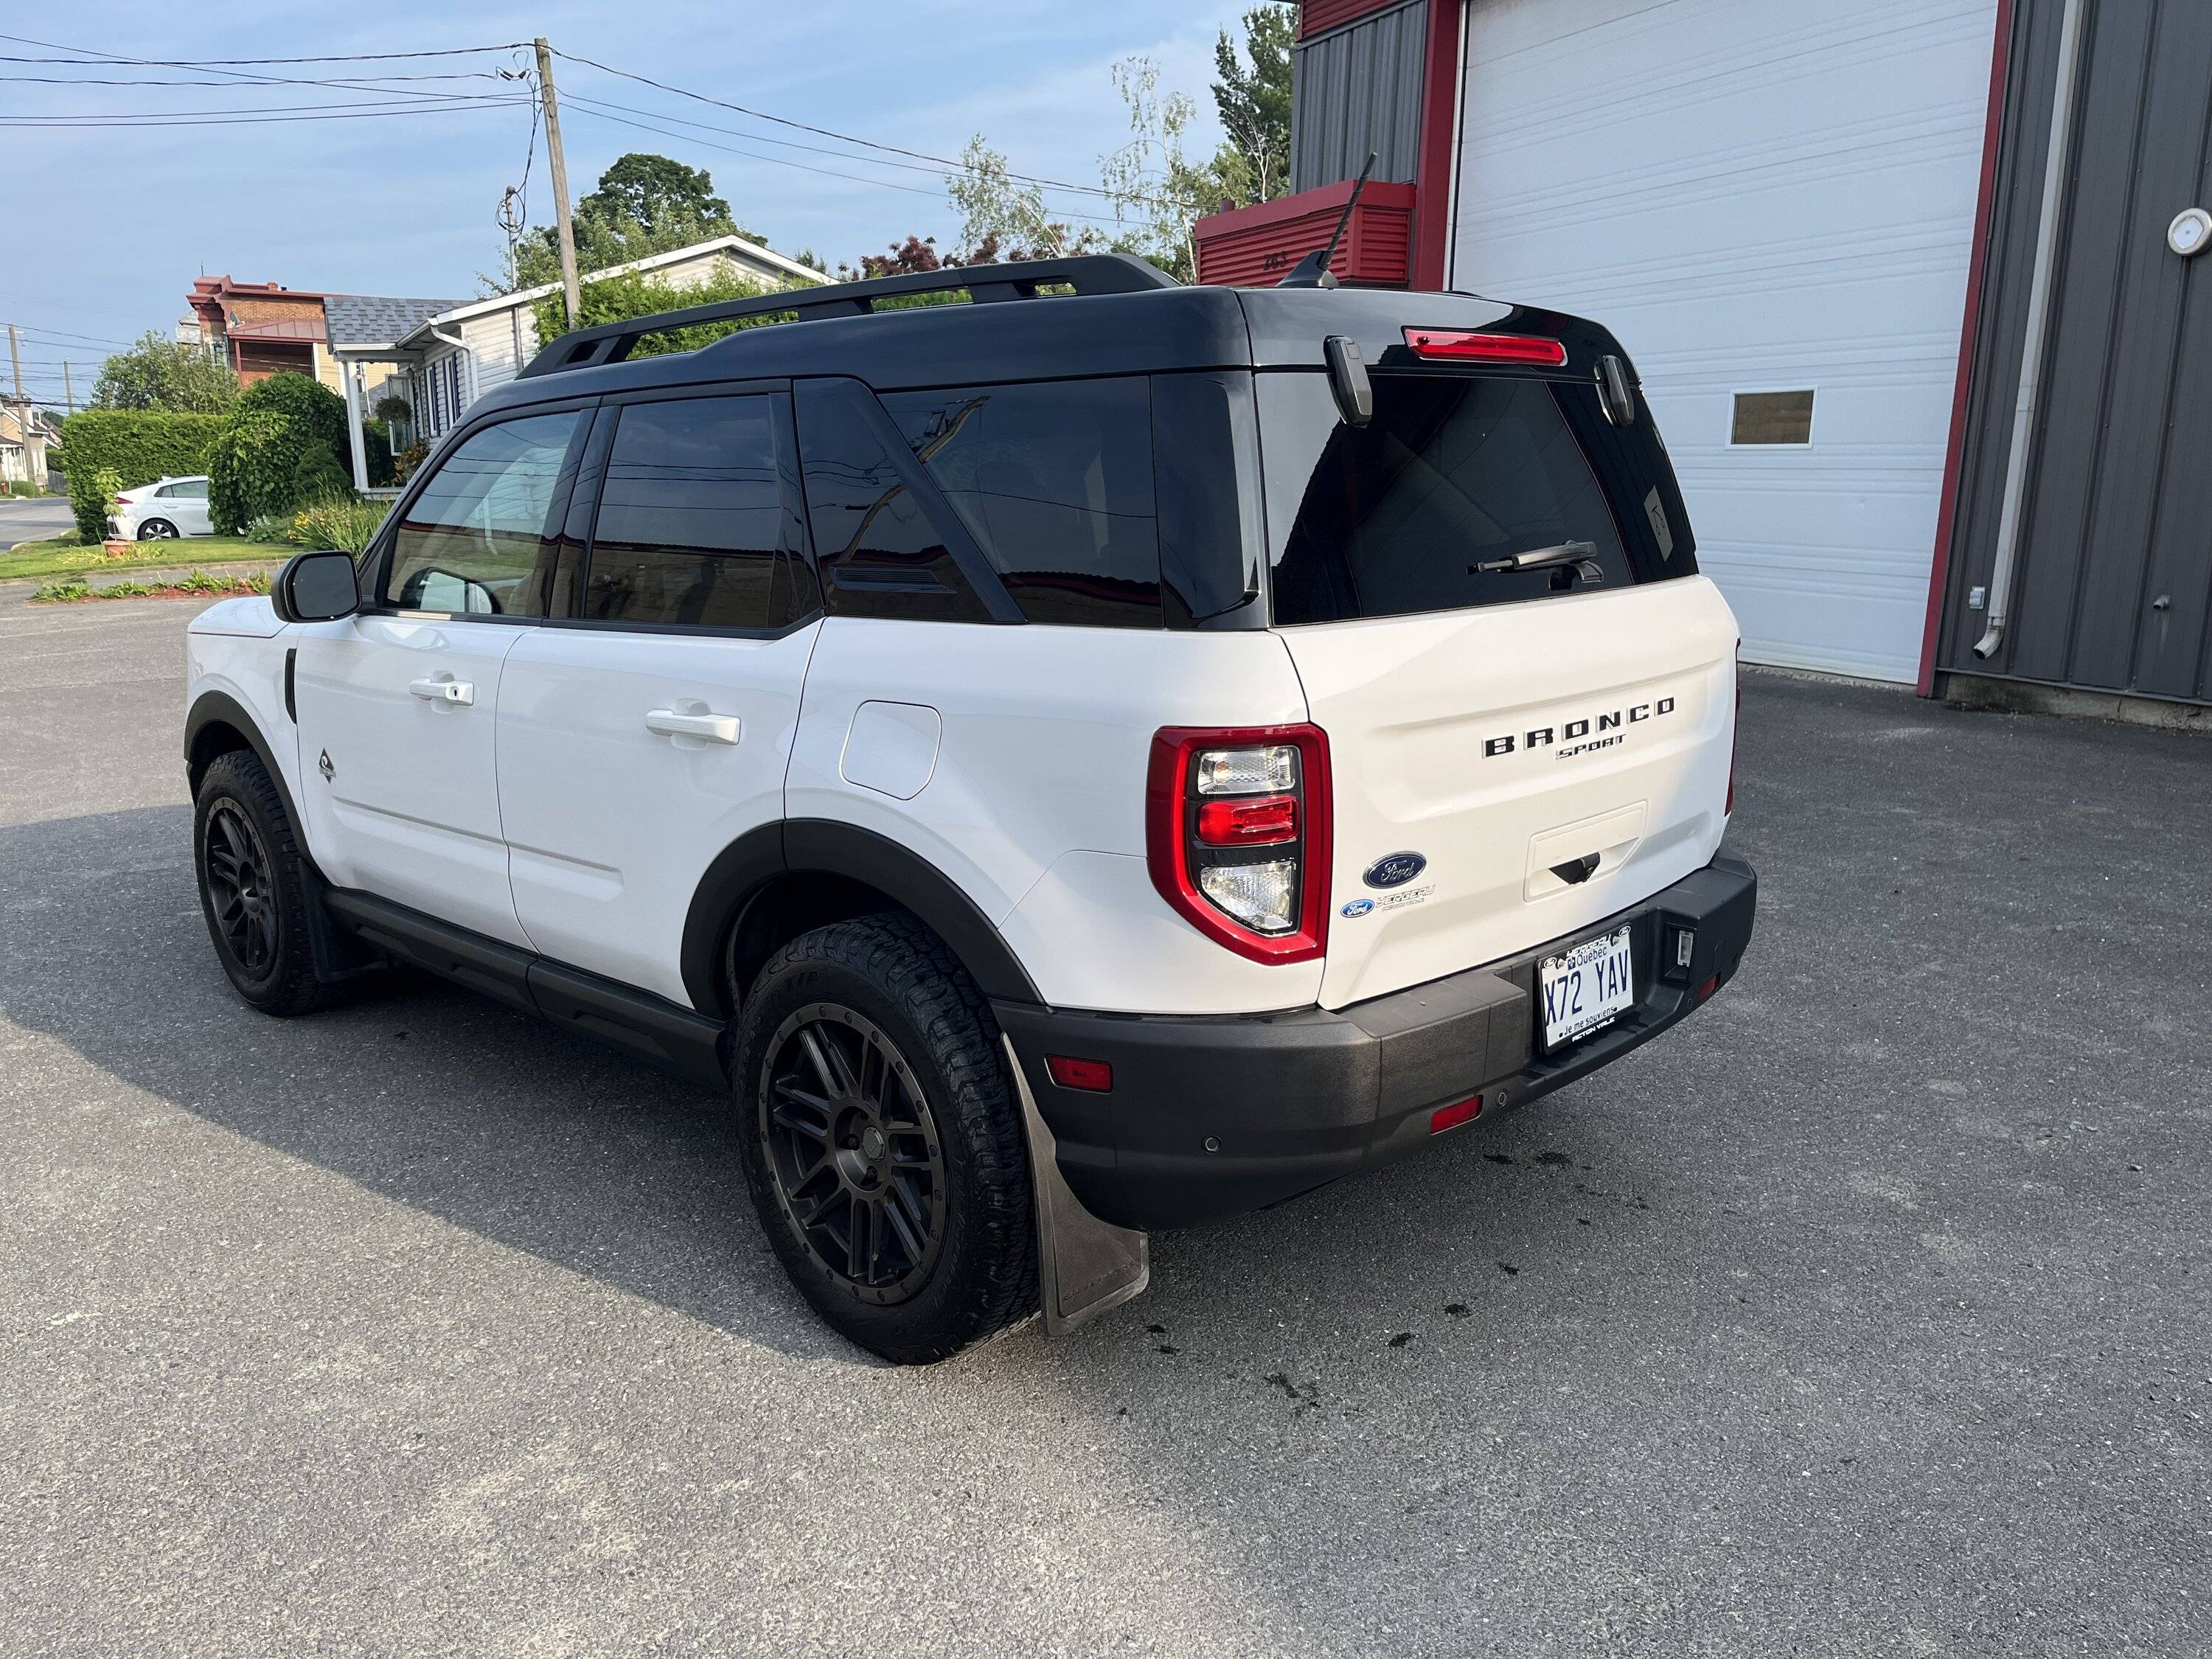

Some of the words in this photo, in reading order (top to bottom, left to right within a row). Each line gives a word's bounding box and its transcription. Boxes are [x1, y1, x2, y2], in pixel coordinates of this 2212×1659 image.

[1482, 697, 1674, 759] BRONCO
[1556, 734, 1627, 759] SPORT
[1544, 970, 1583, 1027] X72
[1595, 949, 1628, 1002] YAV
[1564, 1026, 1572, 1035] Je
[1573, 1020, 1584, 1030] me
[1585, 1006, 1614, 1025] souviens
